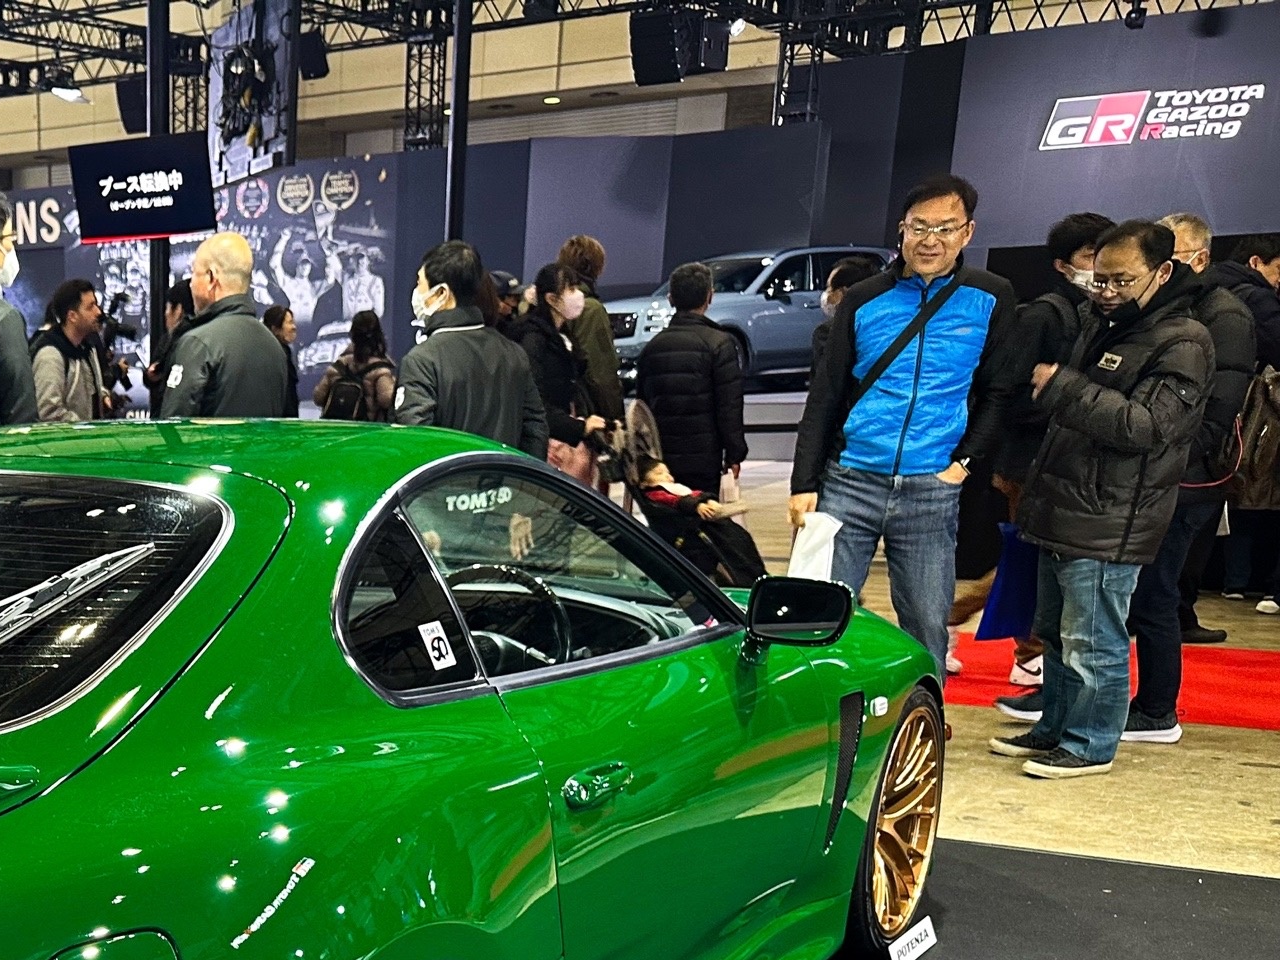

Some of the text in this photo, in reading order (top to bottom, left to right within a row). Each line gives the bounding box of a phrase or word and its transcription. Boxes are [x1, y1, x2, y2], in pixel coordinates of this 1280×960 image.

[1154, 84, 1265, 107] TOYOTA
[1146, 102, 1251, 124] GAZOO
[1046, 113, 1135, 146] GR
[1139, 120, 1242, 140] Racing
[896, 928, 929, 960] POTENZA
